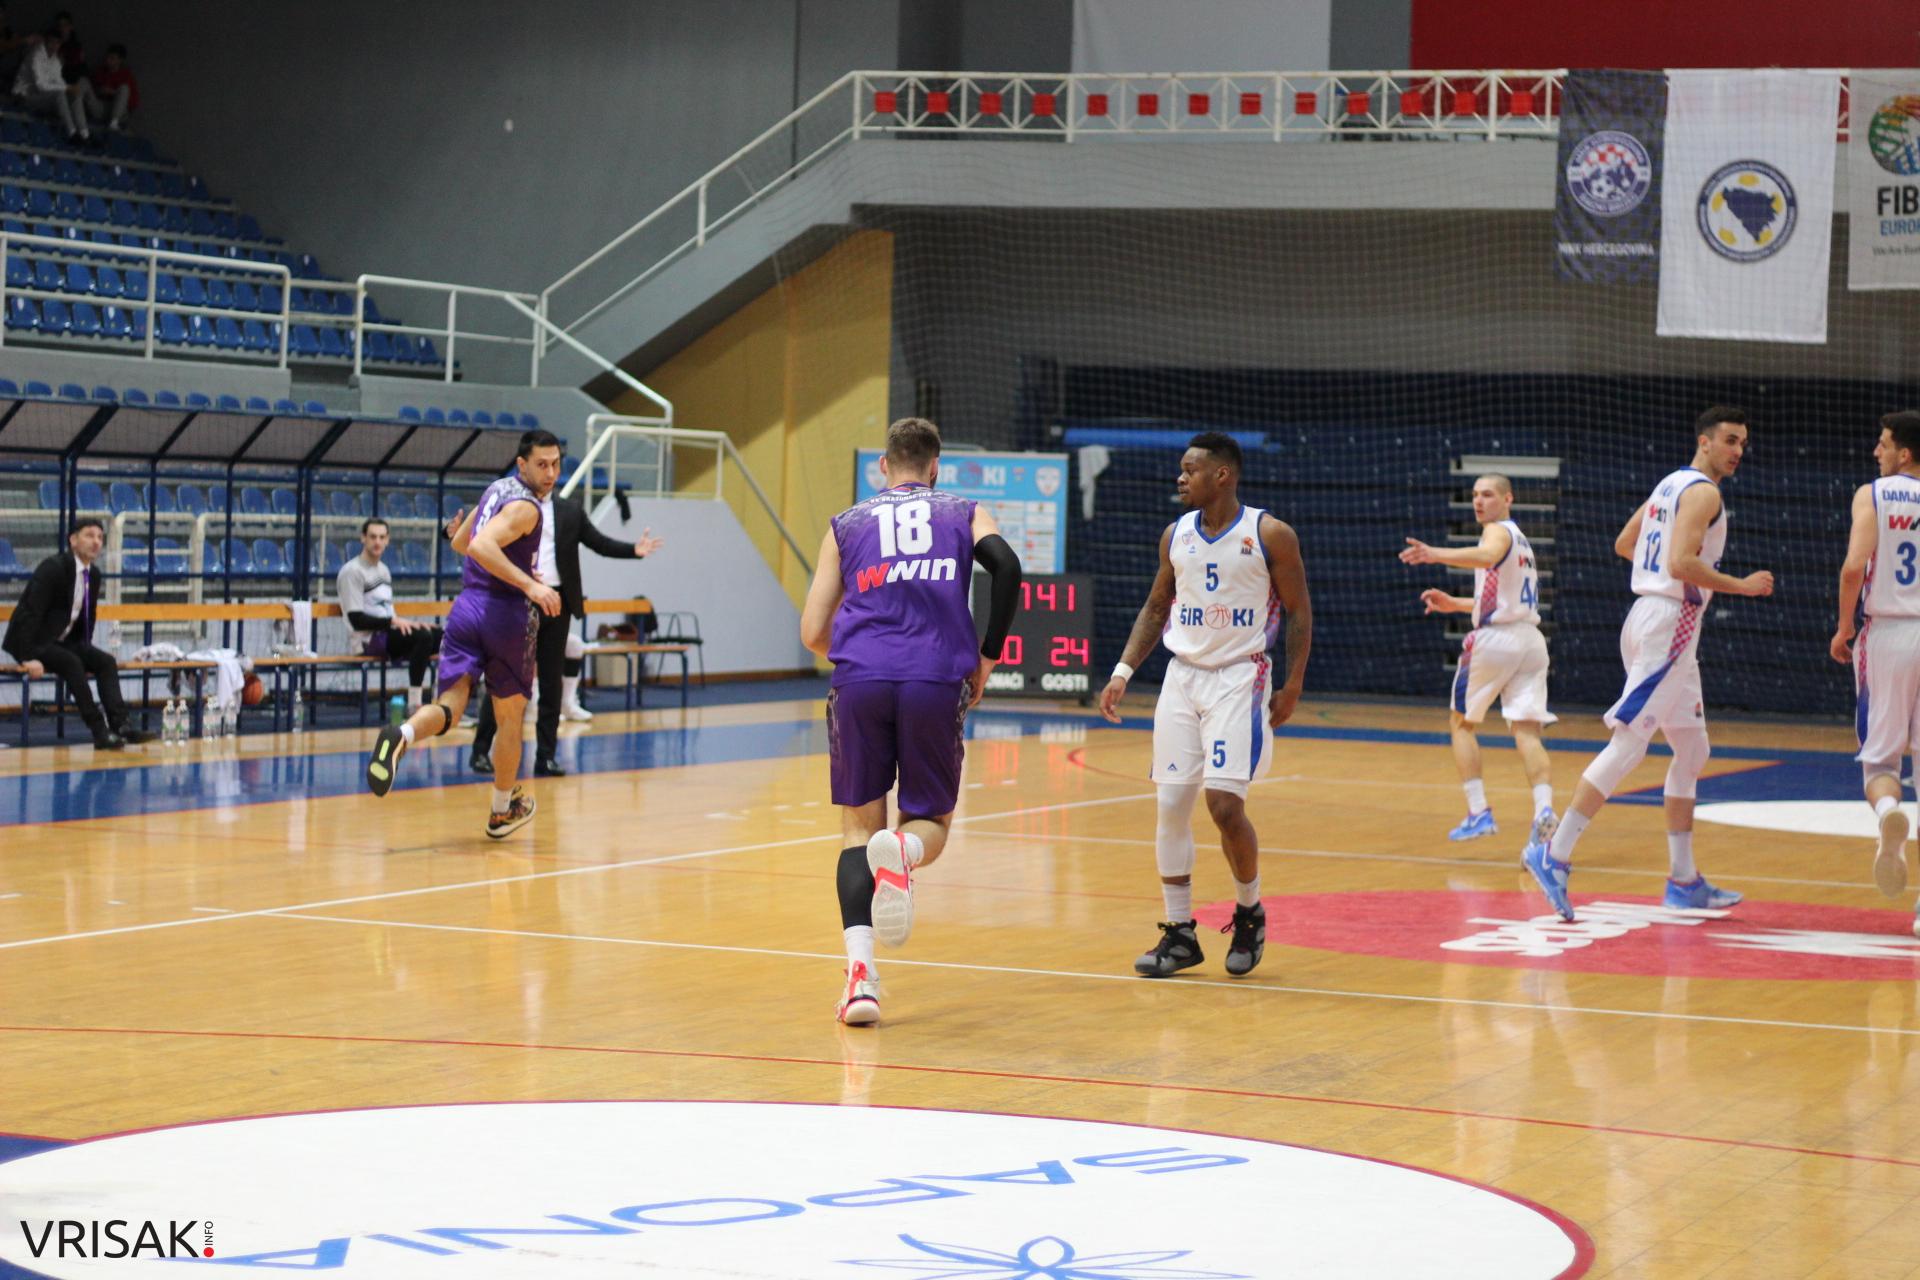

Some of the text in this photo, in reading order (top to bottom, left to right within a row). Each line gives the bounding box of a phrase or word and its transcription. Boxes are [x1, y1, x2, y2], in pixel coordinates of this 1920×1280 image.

[871, 500, 934, 559] 18
[1643, 530, 1661, 574] 12
[1895, 541, 1918, 587] 3
[1205, 562, 1220, 593] 5
[1050, 636, 1089, 667] 24
[1041, 671, 1090, 692] GOSTI
[1211, 739, 1227, 769] 5
[145, 1147, 1250, 1270] SAPONIA
